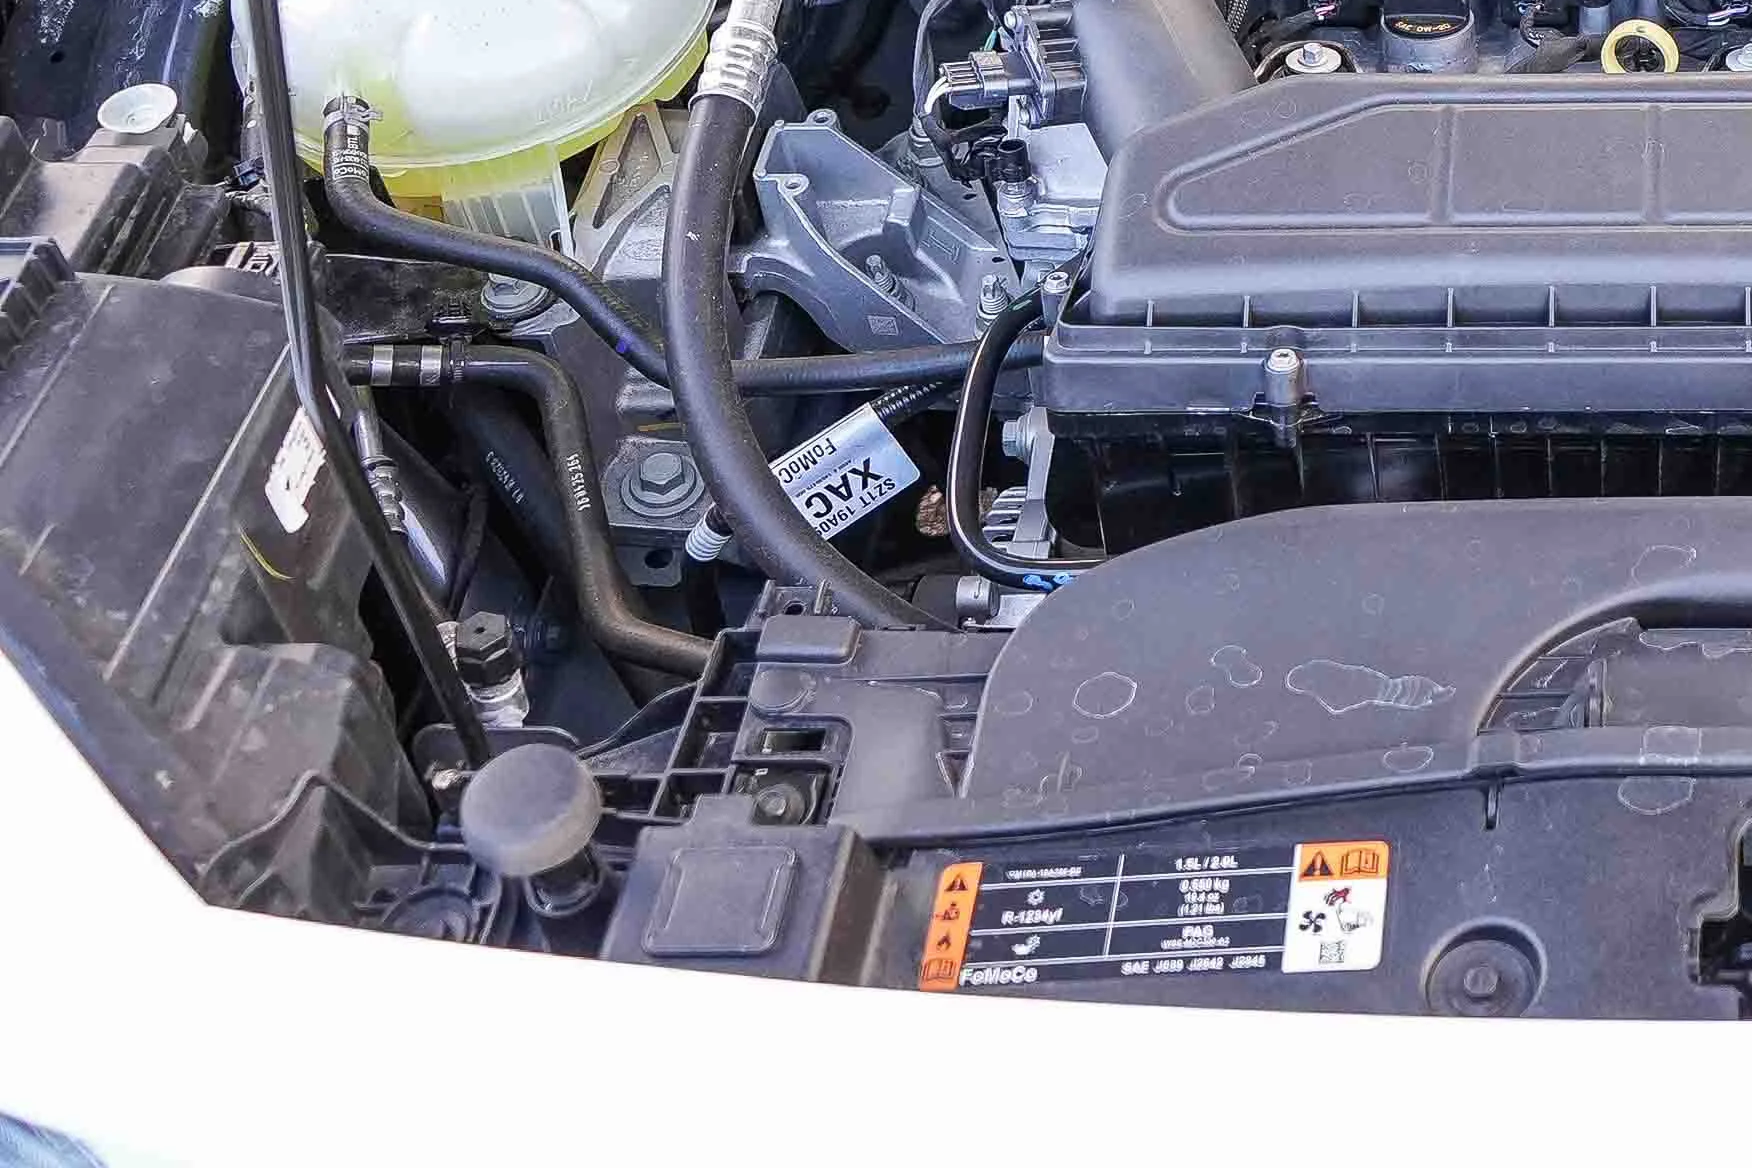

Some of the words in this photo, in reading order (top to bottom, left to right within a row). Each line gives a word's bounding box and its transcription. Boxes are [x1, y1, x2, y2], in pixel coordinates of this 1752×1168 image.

[804, 455, 883, 520] XAC
[860, 477, 896, 509] SZ1T
[959, 965, 1038, 986] FoMoCo
[1121, 960, 1150, 976] SAE
